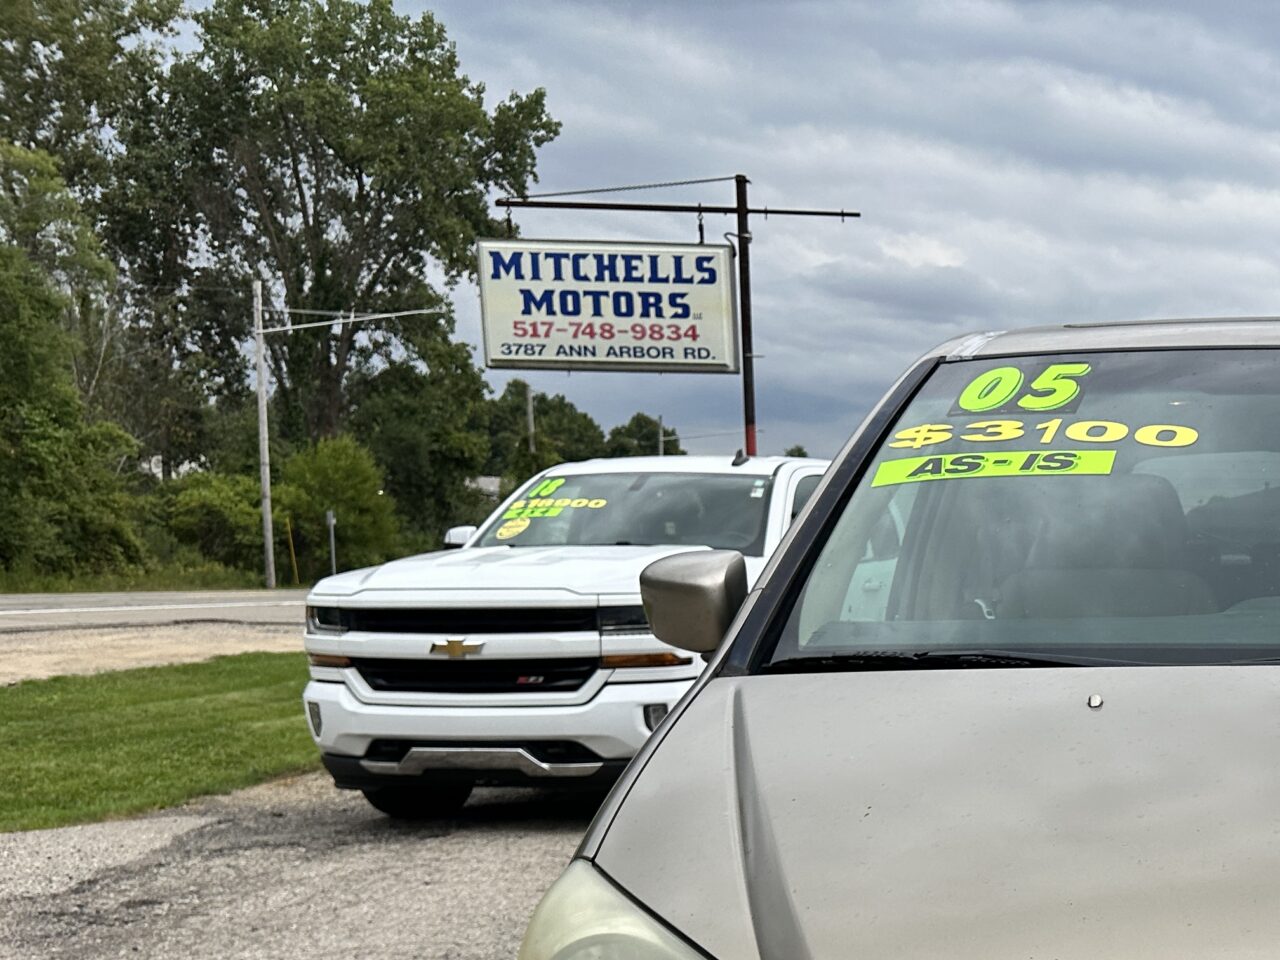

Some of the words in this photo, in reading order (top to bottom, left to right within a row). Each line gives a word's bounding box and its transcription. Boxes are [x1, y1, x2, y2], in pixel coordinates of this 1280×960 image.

[489, 251, 718, 285] MITCHELLS
[518, 289, 691, 319] MOTORS
[513, 321, 700, 342] 517-748-9834
[501, 343, 546, 357] 3787
[556, 345, 597, 358] ANN
[606, 346, 675, 359] ARBOR
[683, 347, 716, 360] RD.
[958, 362, 1092, 413] 05
[888, 418, 1199, 449] $3100
[906, 451, 1082, 479] AS-IS
